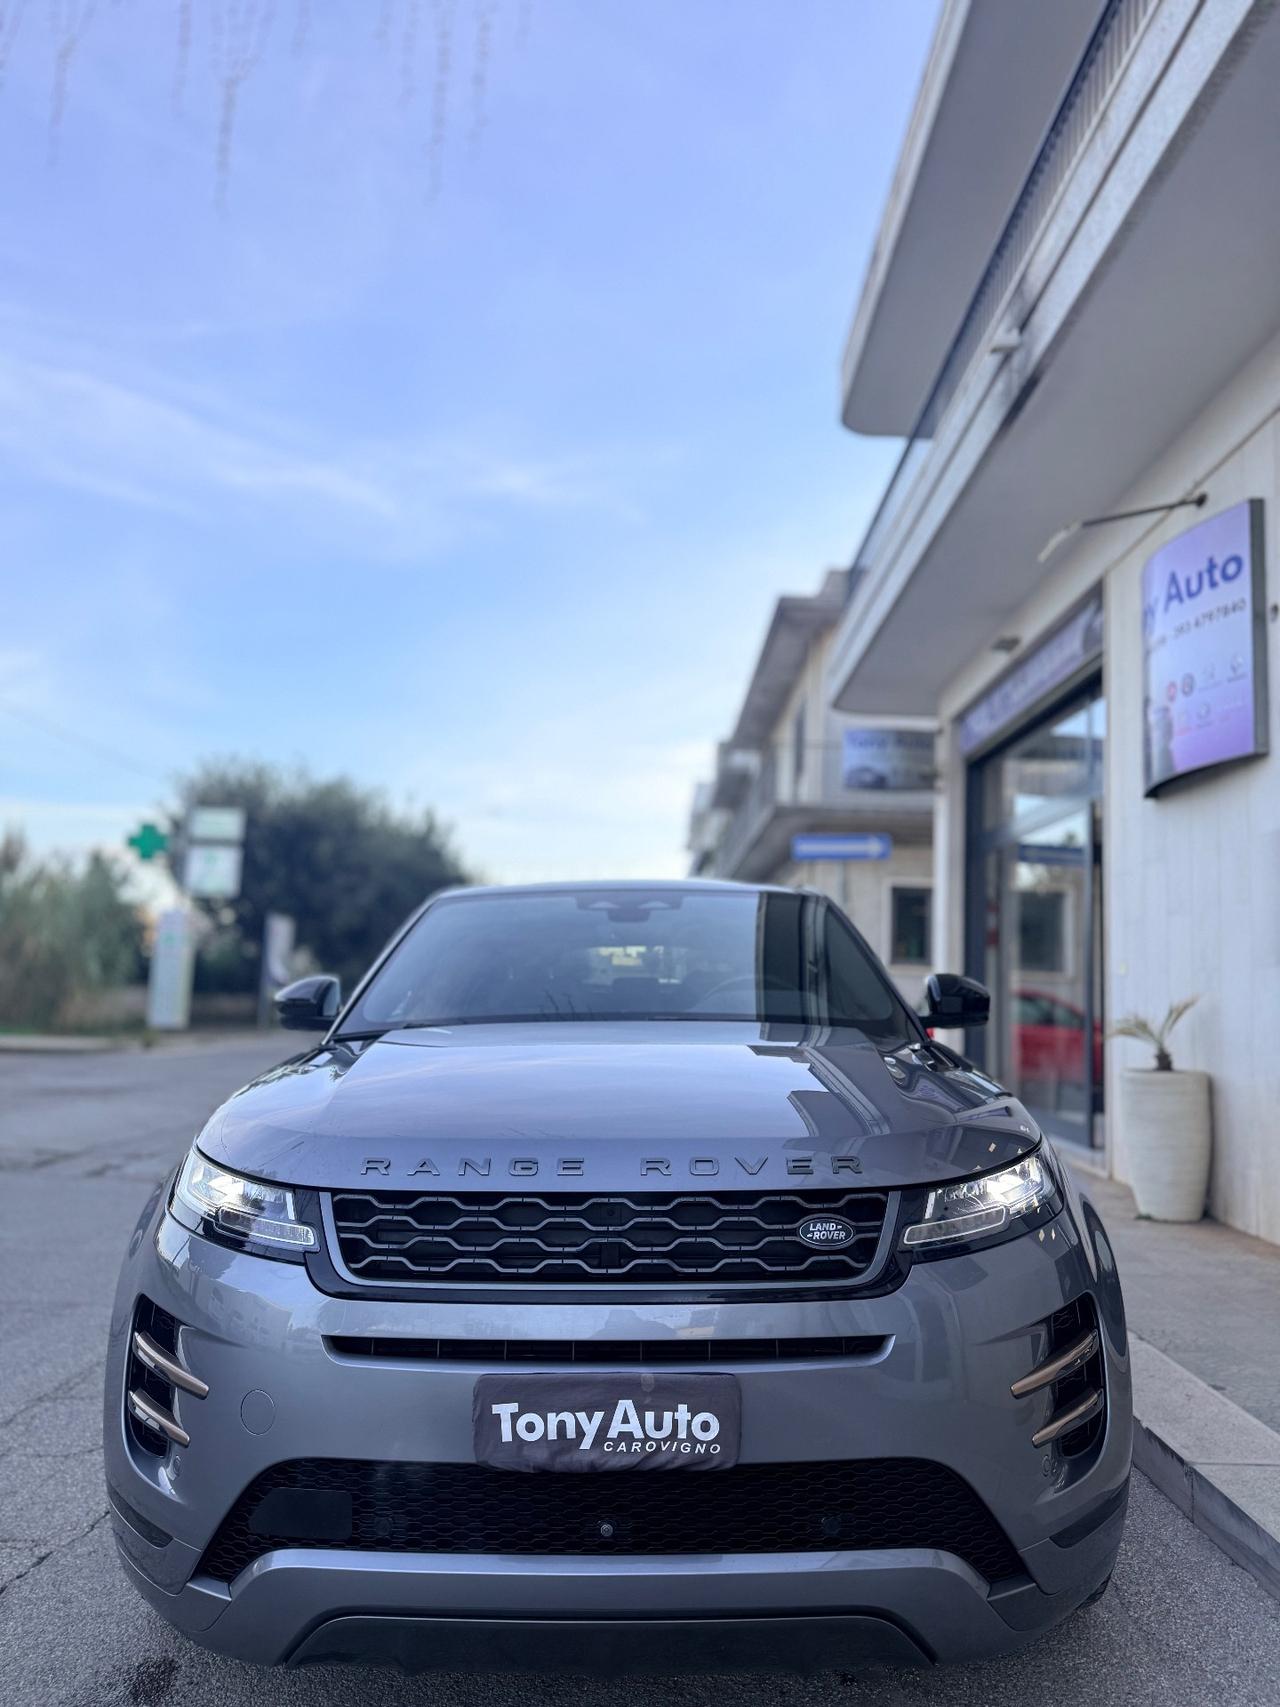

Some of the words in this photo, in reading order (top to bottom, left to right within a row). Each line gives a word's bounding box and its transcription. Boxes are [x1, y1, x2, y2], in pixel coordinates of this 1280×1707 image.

[1164, 555, 1243, 613] Auto
[360, 1156, 585, 1177] RANGE
[640, 1156, 864, 1176] ROVER
[603, 1440, 721, 1455] CAROVIGNO
